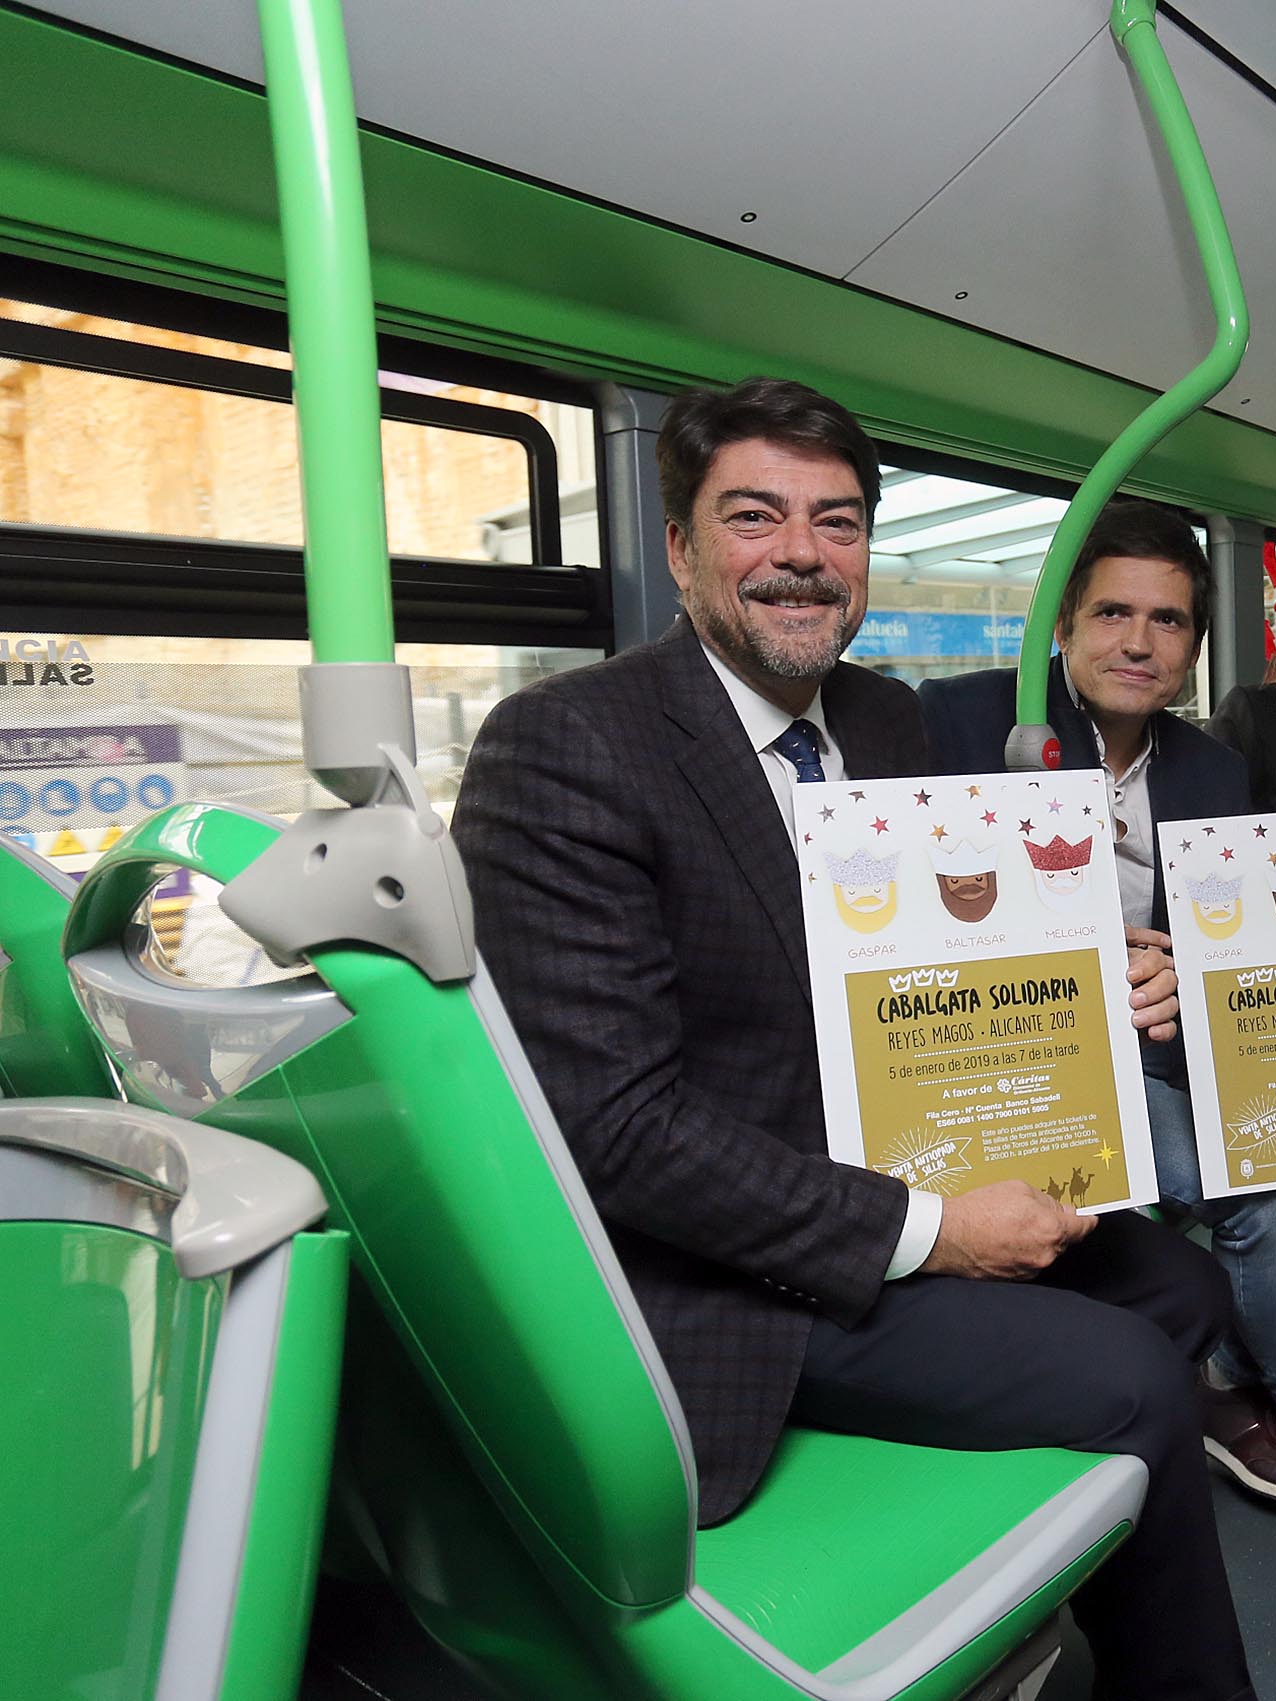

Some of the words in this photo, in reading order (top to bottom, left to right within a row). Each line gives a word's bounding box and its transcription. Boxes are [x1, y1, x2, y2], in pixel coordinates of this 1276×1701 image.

[945, 934, 1006, 949] BALTASAR
[1045, 925, 1097, 939] MELCHOR
[848, 944, 897, 959] GASPAR
[1204, 948, 1243, 960] GASPAR
[877, 988, 981, 1024] CABALGATA
[989, 977, 1079, 1010] SOLIDARIA
[888, 1028, 926, 1051] REYES
[932, 1022, 974, 1044] MAGOS
[990, 1014, 1044, 1037] ALICANTE
[1049, 1010, 1075, 1030] 2019
[1237, 1015, 1268, 1034] REYES
[1238, 1045, 1245, 1057] 5
[1246, 1044, 1258, 1055] de
[889, 1066, 896, 1080] 5
[899, 1065, 913, 1078] de
[915, 1062, 945, 1076] enero
[948, 1058, 961, 1072] de
[963, 1054, 990, 1070] 2019
[993, 1055, 999, 1066] a
[1001, 1052, 1017, 1064] las
[1019, 1049, 1025, 1062] 7
[1028, 1048, 1041, 1061] de
[1043, 1046, 1053, 1058] la
[1055, 1043, 1080, 1057] tarde
[942, 1089, 951, 1099] A
[952, 1087, 978, 1098] favor
[980, 1084, 992, 1094] de
[1011, 1074, 1050, 1086] Cáritas
[926, 1111, 940, 1120] Fila
[975, 1103, 1002, 1112] Cuenta
[1005, 1099, 1029, 1108] Banco
[1030, 1093, 1061, 1104] Sabadell
[1013, 1107, 1030, 1116] 0101
[1238, 1122, 1260, 1135] VENTA
[914, 1142, 956, 1169] ANTICIPADA
[906, 1170, 918, 1184] DE
[922, 1157, 946, 1177] SILLAS
